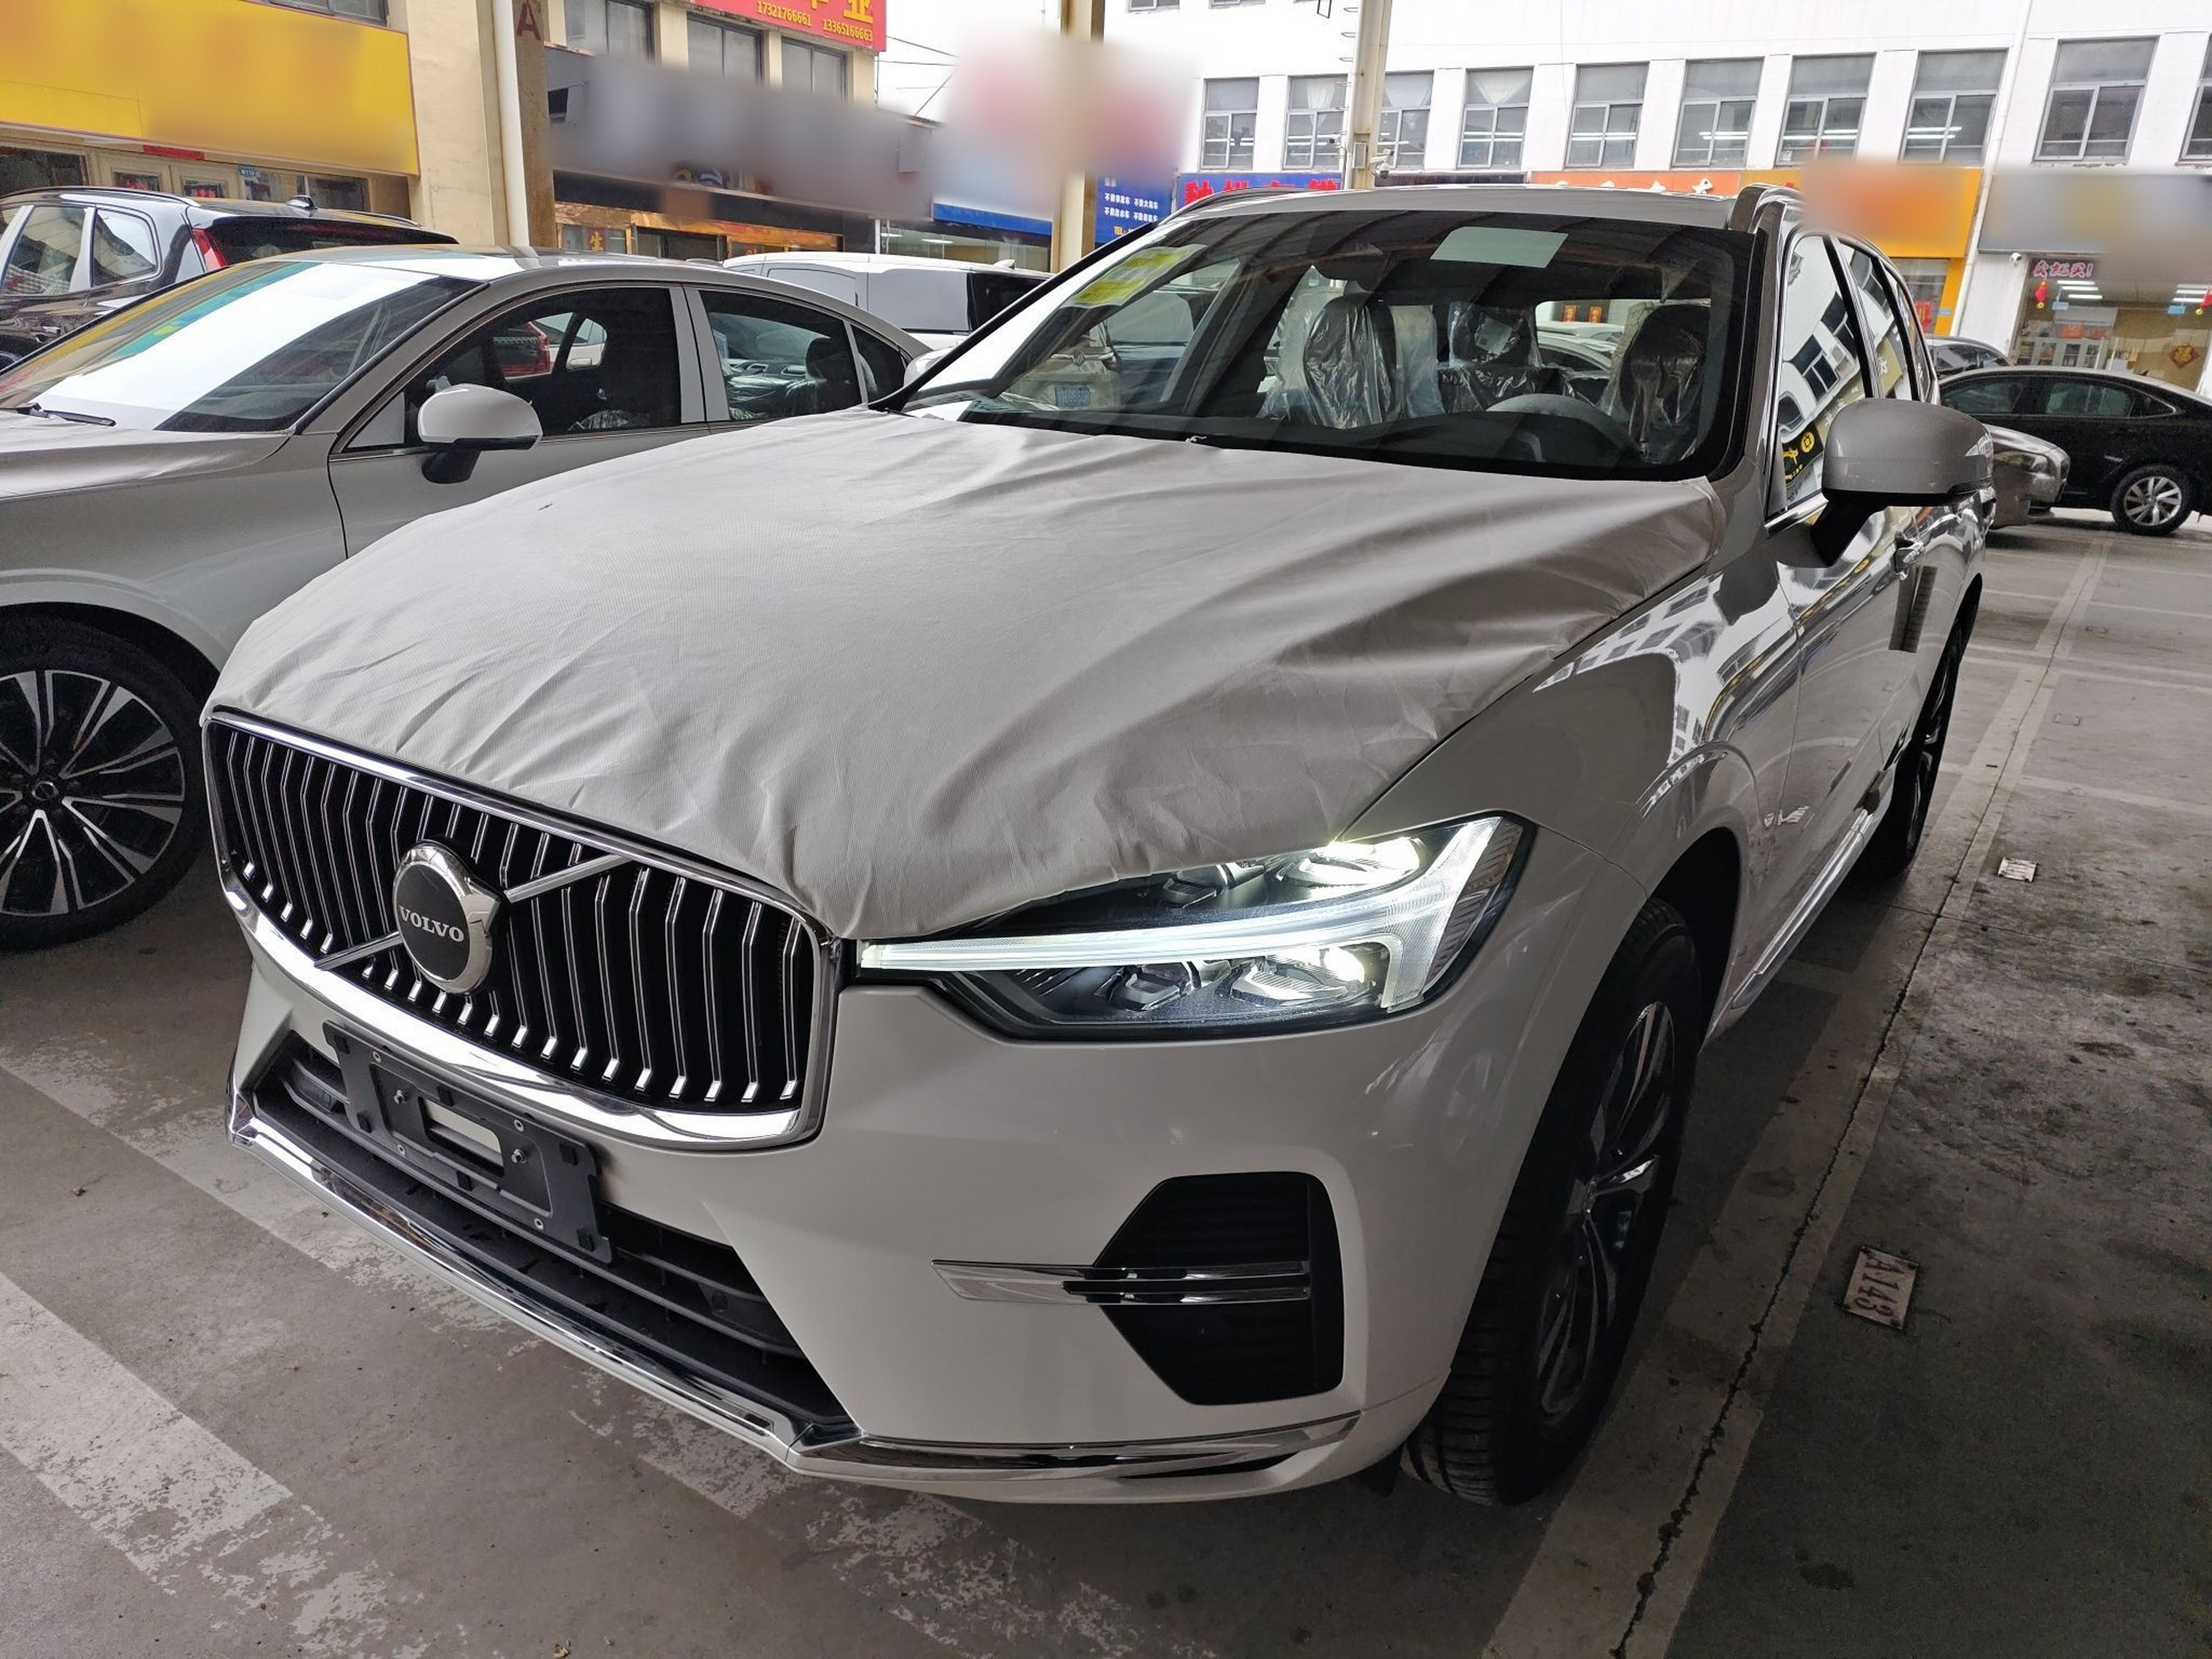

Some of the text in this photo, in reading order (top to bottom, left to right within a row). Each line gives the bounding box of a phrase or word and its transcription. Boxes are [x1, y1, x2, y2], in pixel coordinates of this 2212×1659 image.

[516, 0, 541, 40] A
[757, 1, 873, 41] 17321766661 13365166663
[399, 905, 464, 942] VOLVO
